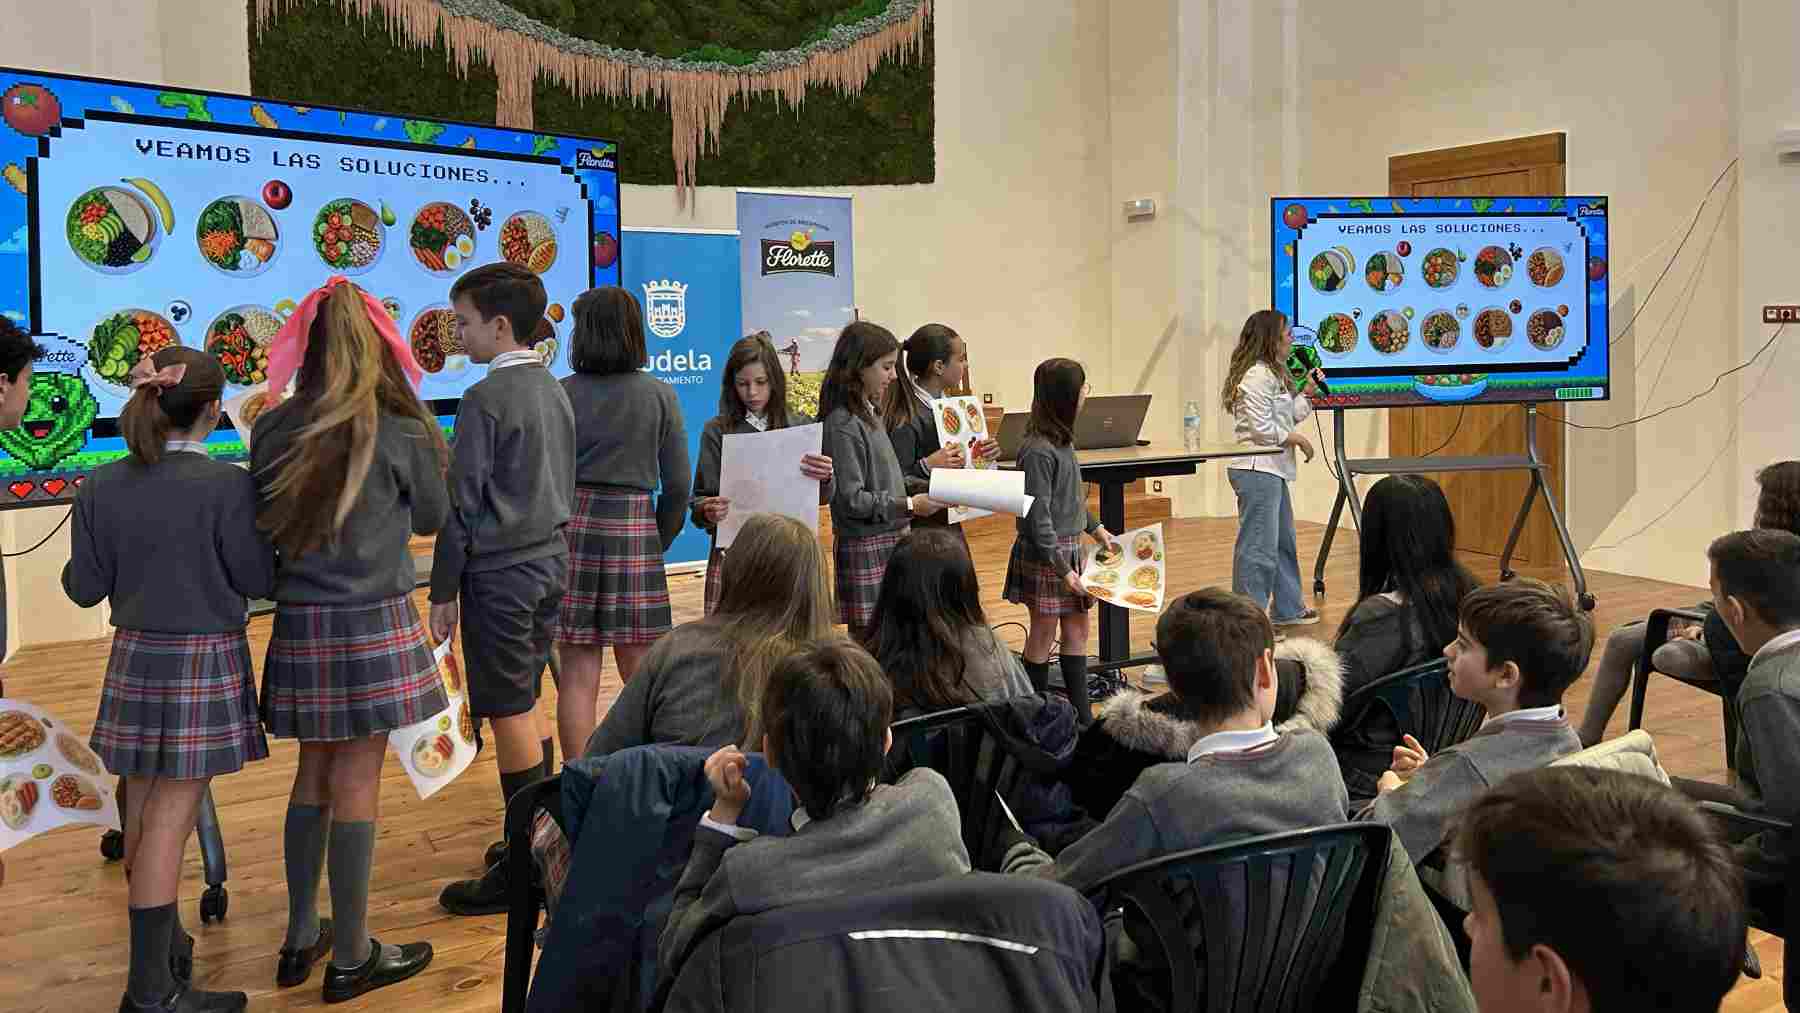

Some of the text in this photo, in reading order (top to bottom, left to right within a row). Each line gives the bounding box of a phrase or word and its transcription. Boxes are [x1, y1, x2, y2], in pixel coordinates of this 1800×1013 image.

[135, 138, 526, 187] VEAMOS LAS SOLUCIONES...
[1338, 223, 1545, 234] VEAMOS LAS SOLUCIONES...
[766, 245, 832, 267] Florette
[640, 349, 712, 373] udela
